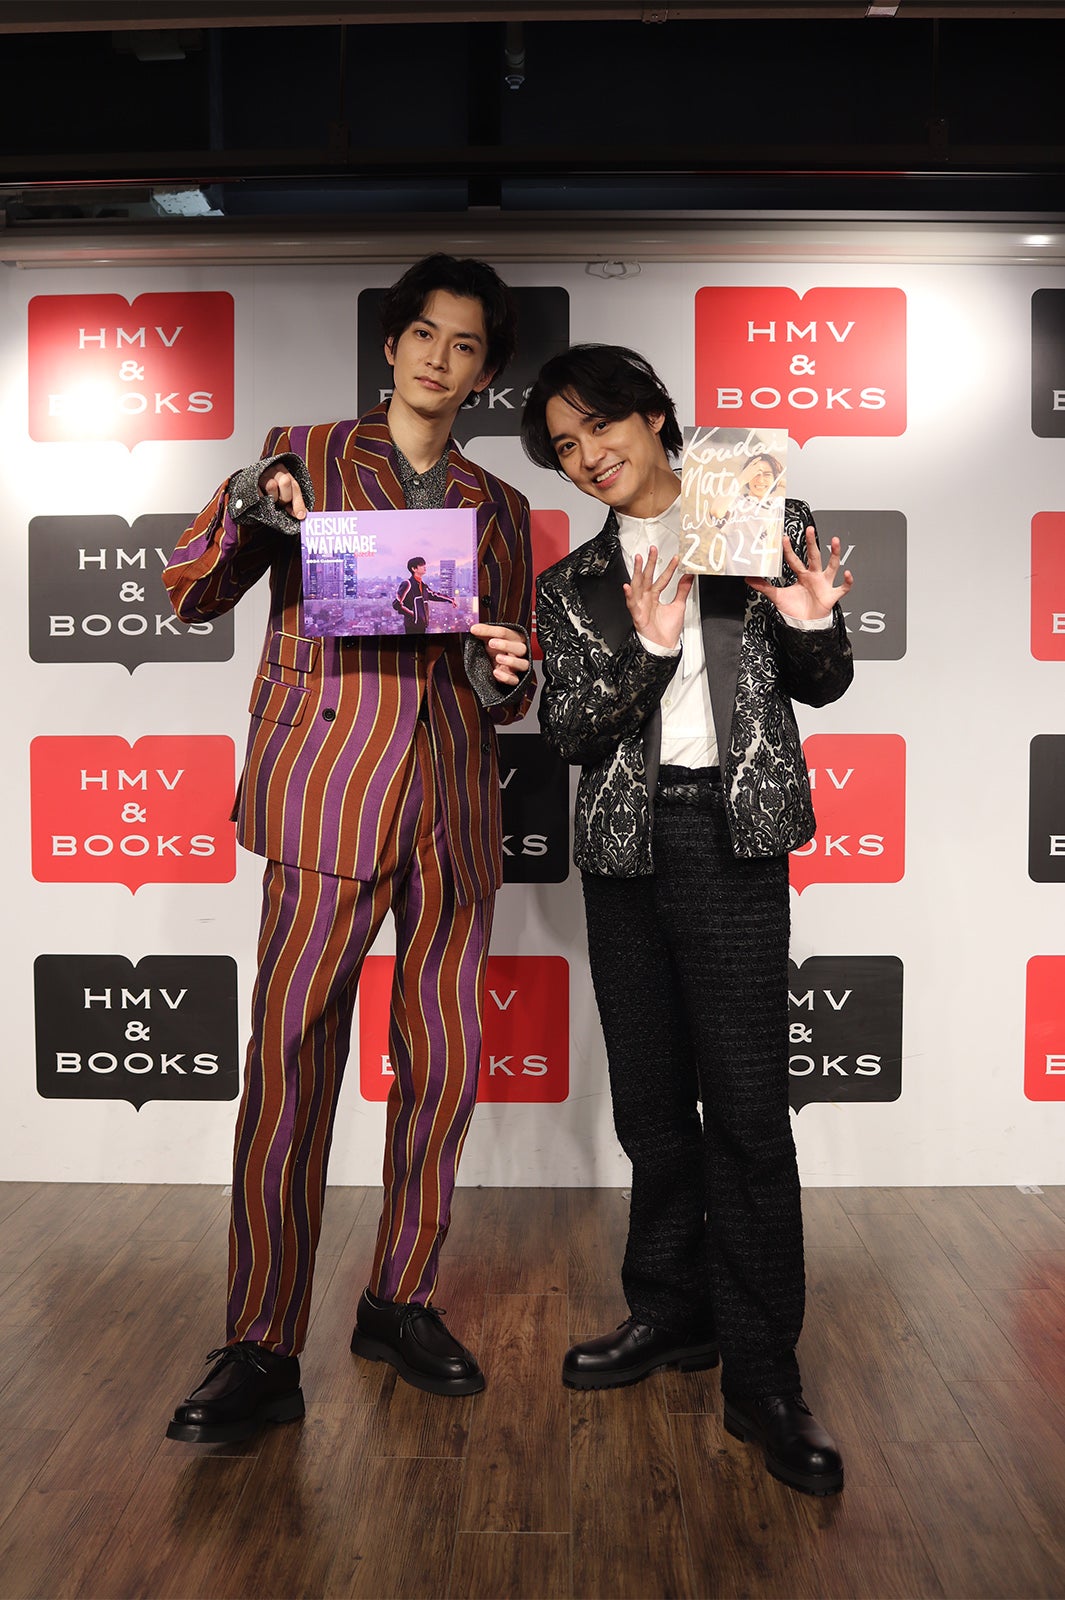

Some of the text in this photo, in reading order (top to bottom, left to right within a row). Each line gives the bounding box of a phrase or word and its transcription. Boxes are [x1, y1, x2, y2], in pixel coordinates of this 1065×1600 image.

[78, 326, 183, 349] HMV
[747, 321, 856, 343] HMV
[119, 360, 145, 382] &
[789, 354, 816, 376] &
[716, 387, 887, 410] BOOKS
[305, 516, 358, 536] KEISUKE
[305, 535, 377, 554] WATANABE
[681, 527, 778, 577] 2024
[119, 581, 145, 602] &
[80, 769, 185, 790] HMV
[121, 802, 147, 823] &
[51, 834, 216, 856] BOOKS
[84, 988, 188, 1009] HMV
[787, 990, 853, 1011] MV
[124, 1021, 150, 1041] &
[789, 1022, 813, 1043] &
[55, 1052, 219, 1075] BOOKS
[788, 1054, 882, 1077] OKS
